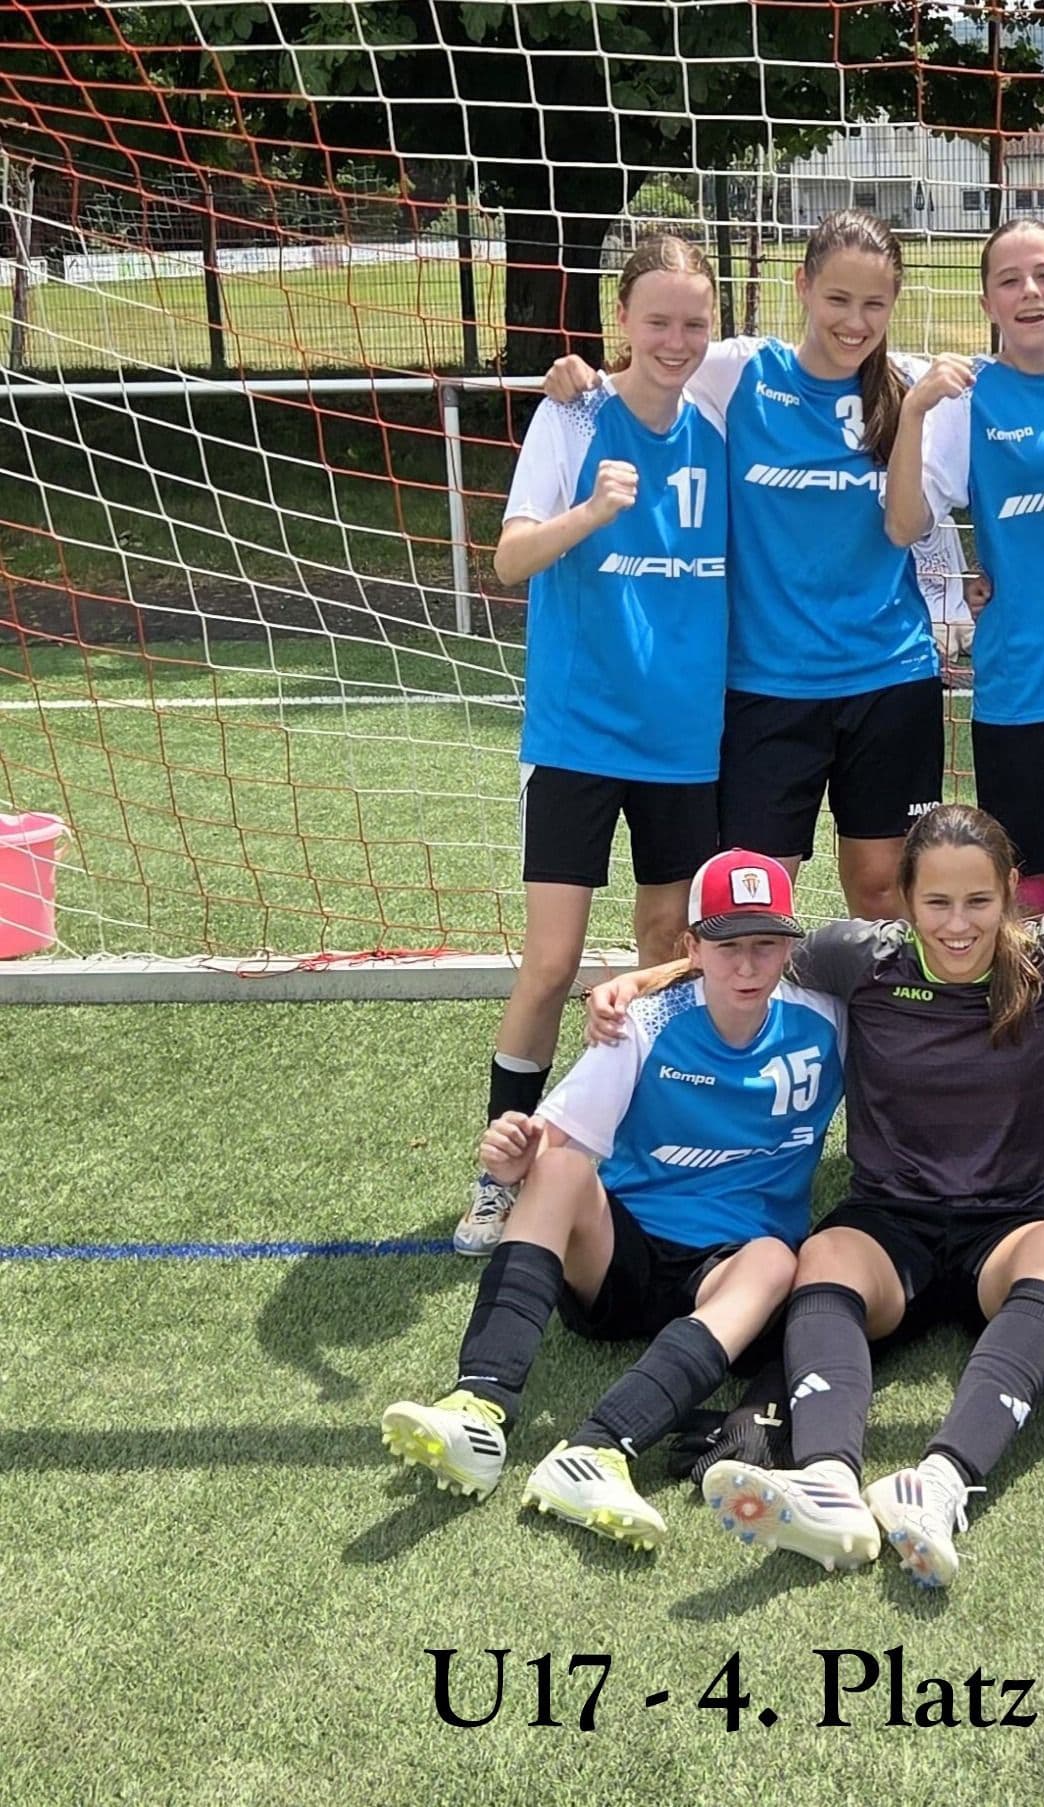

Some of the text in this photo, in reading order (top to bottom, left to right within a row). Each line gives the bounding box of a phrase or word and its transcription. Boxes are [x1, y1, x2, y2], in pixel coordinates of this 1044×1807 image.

[756, 381, 800, 407] Kempa
[986, 427, 1034, 442] Kempa
[667, 467, 707, 528] 17
[634, 557, 726, 577] AMG
[892, 986, 934, 1001] JAKO
[659, 1065, 716, 1085] Kempa
[759, 1045, 822, 1116] 15
